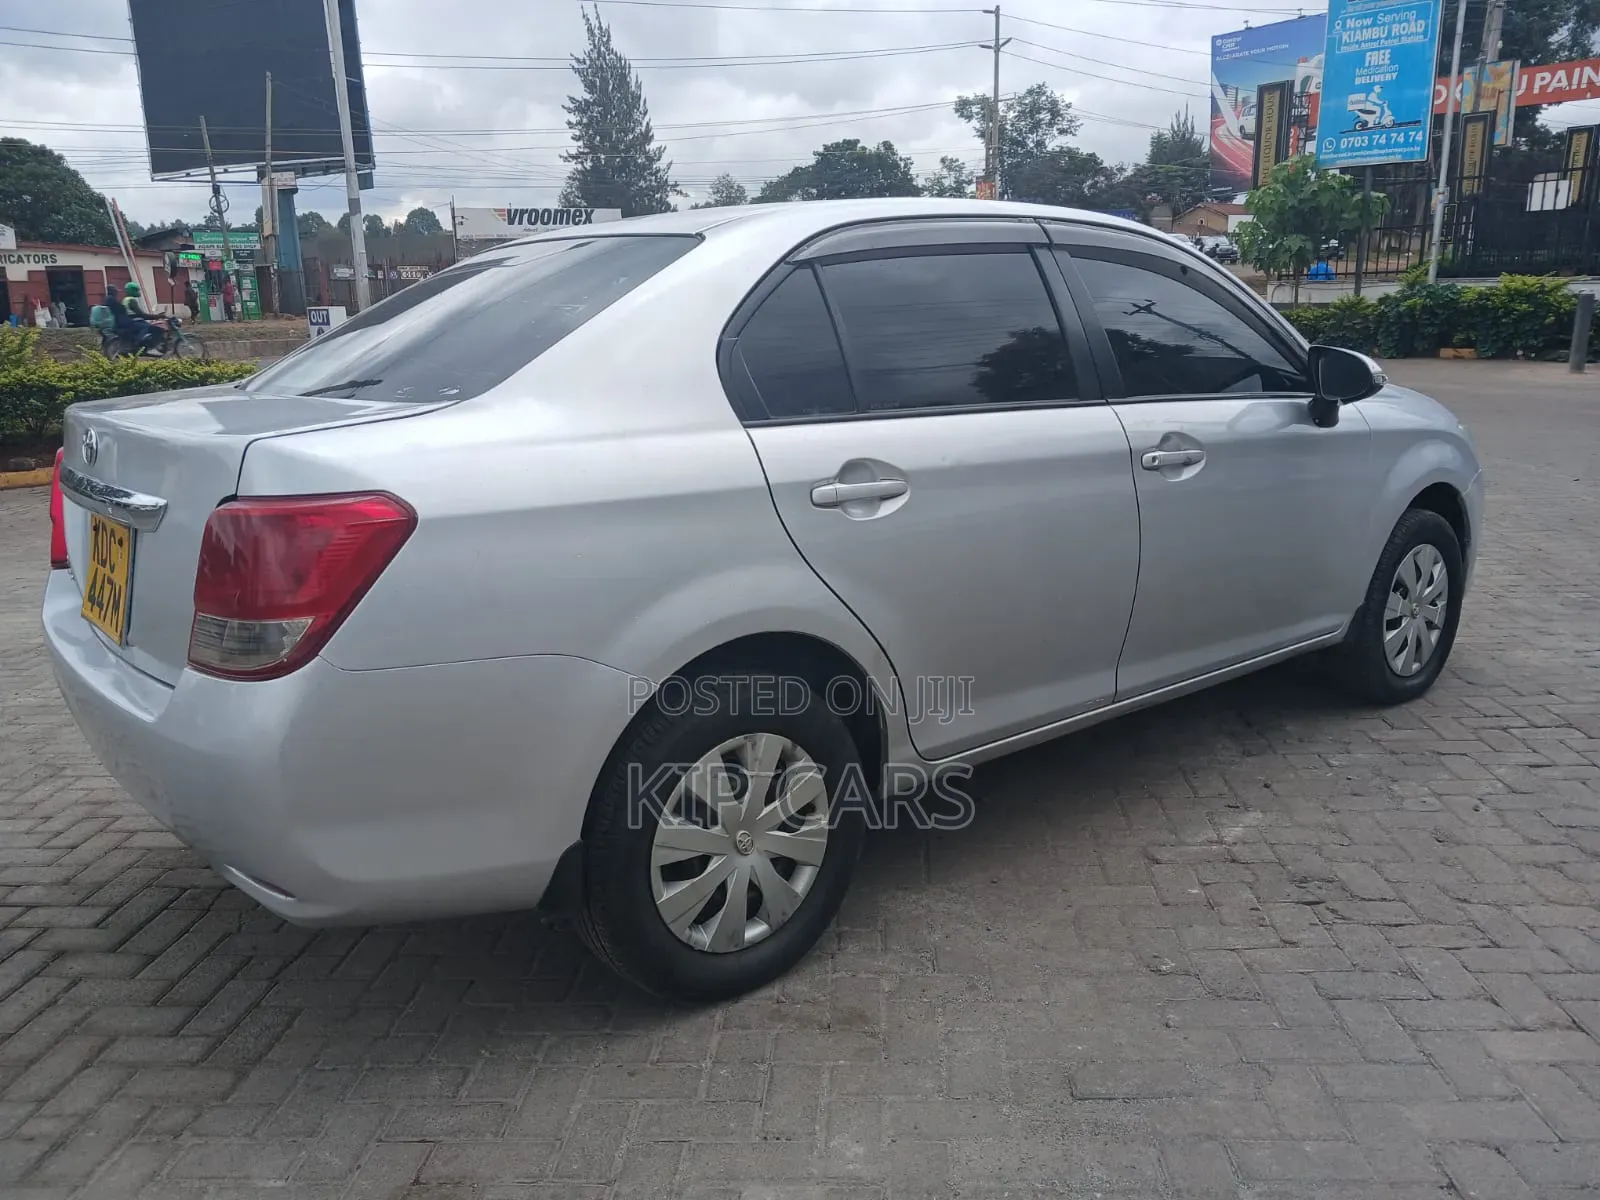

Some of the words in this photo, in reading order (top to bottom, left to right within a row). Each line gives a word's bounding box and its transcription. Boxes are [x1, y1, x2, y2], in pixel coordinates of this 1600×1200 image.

[1347, 17, 1373, 28] Now
[1378, 9, 1416, 23] Serving
[1342, 25, 1388, 44] KIAMBU
[1391, 19, 1425, 36] ROAD
[1365, 49, 1391, 66] FREE
[1354, 72, 1398, 86] DELIVERY
[1355, 63, 1399, 76] Medication
[1262, 127, 1273, 163] LIQUOR
[1340, 135, 1369, 149] 0703
[1372, 133, 1387, 146] 74
[1390, 131, 1405, 144] 74
[1408, 130, 1424, 143] 74
[506, 207, 595, 226] vroomex
[310, 310, 328, 324] OUT
[92, 517, 117, 574] KDC
[87, 568, 122, 633] 447M
